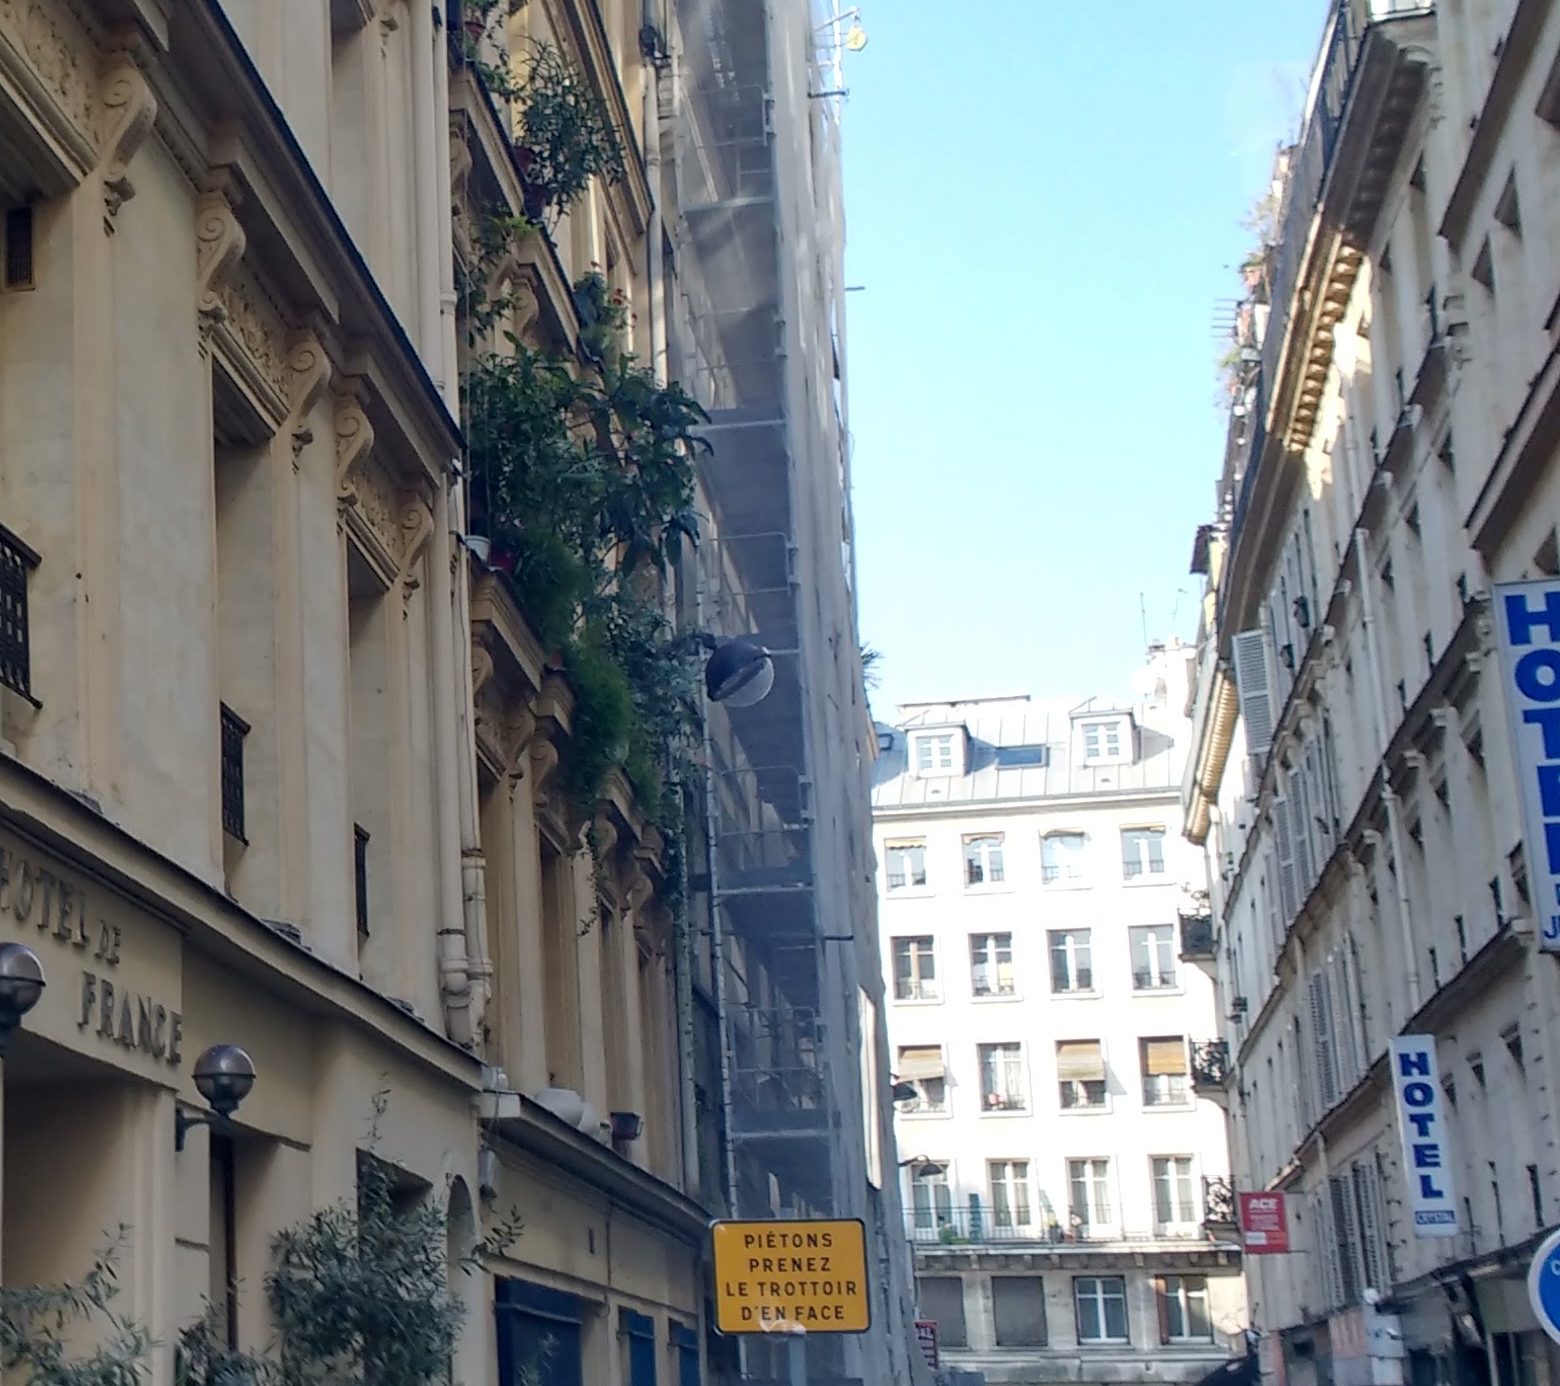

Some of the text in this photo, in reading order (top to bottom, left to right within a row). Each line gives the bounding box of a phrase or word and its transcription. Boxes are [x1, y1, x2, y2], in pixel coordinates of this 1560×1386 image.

[1504, 591, 1560, 876] HOT
[94, 919, 121, 965] DE
[77, 969, 183, 1066] FRANCE
[1398, 1051, 1445, 1199] HOTEL
[749, 1256, 832, 1273] PRENEZ
[725, 1280, 857, 1297] LE TROTTOIR
[741, 1305, 845, 1321] D'EN FACE
